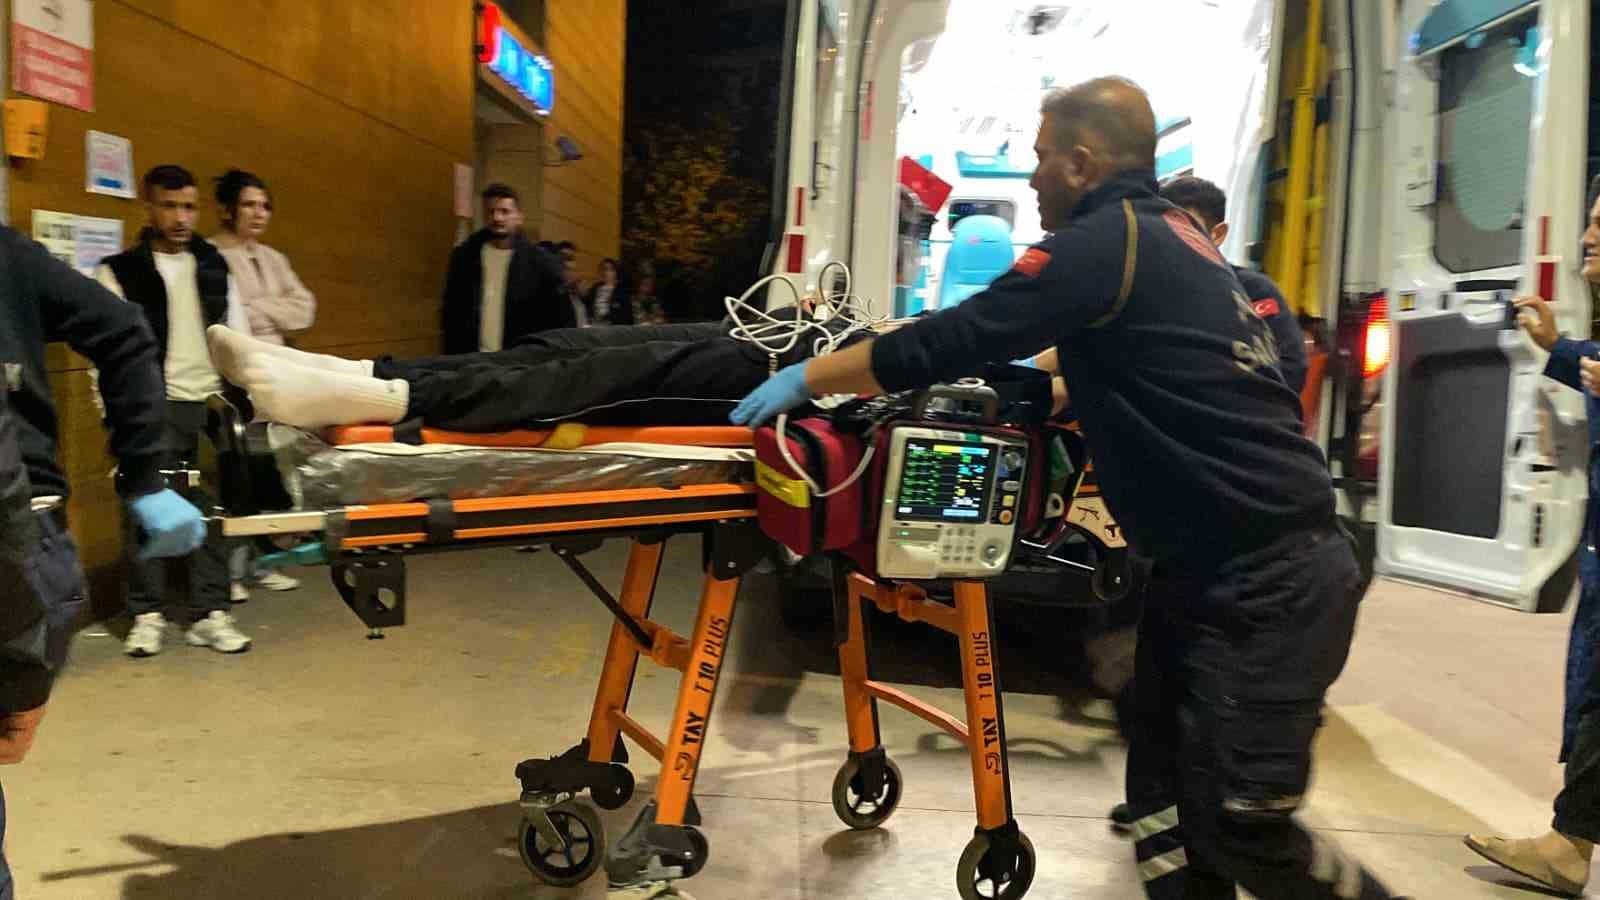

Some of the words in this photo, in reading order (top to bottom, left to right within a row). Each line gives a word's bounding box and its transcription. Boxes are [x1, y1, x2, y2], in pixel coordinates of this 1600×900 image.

[703, 615, 727, 657] PLUS
[972, 631, 991, 666] PLUS
[698, 661, 715, 681] 10
[977, 672, 992, 689] 10
[682, 711, 705, 745] TAY
[982, 717, 998, 748] TAY
